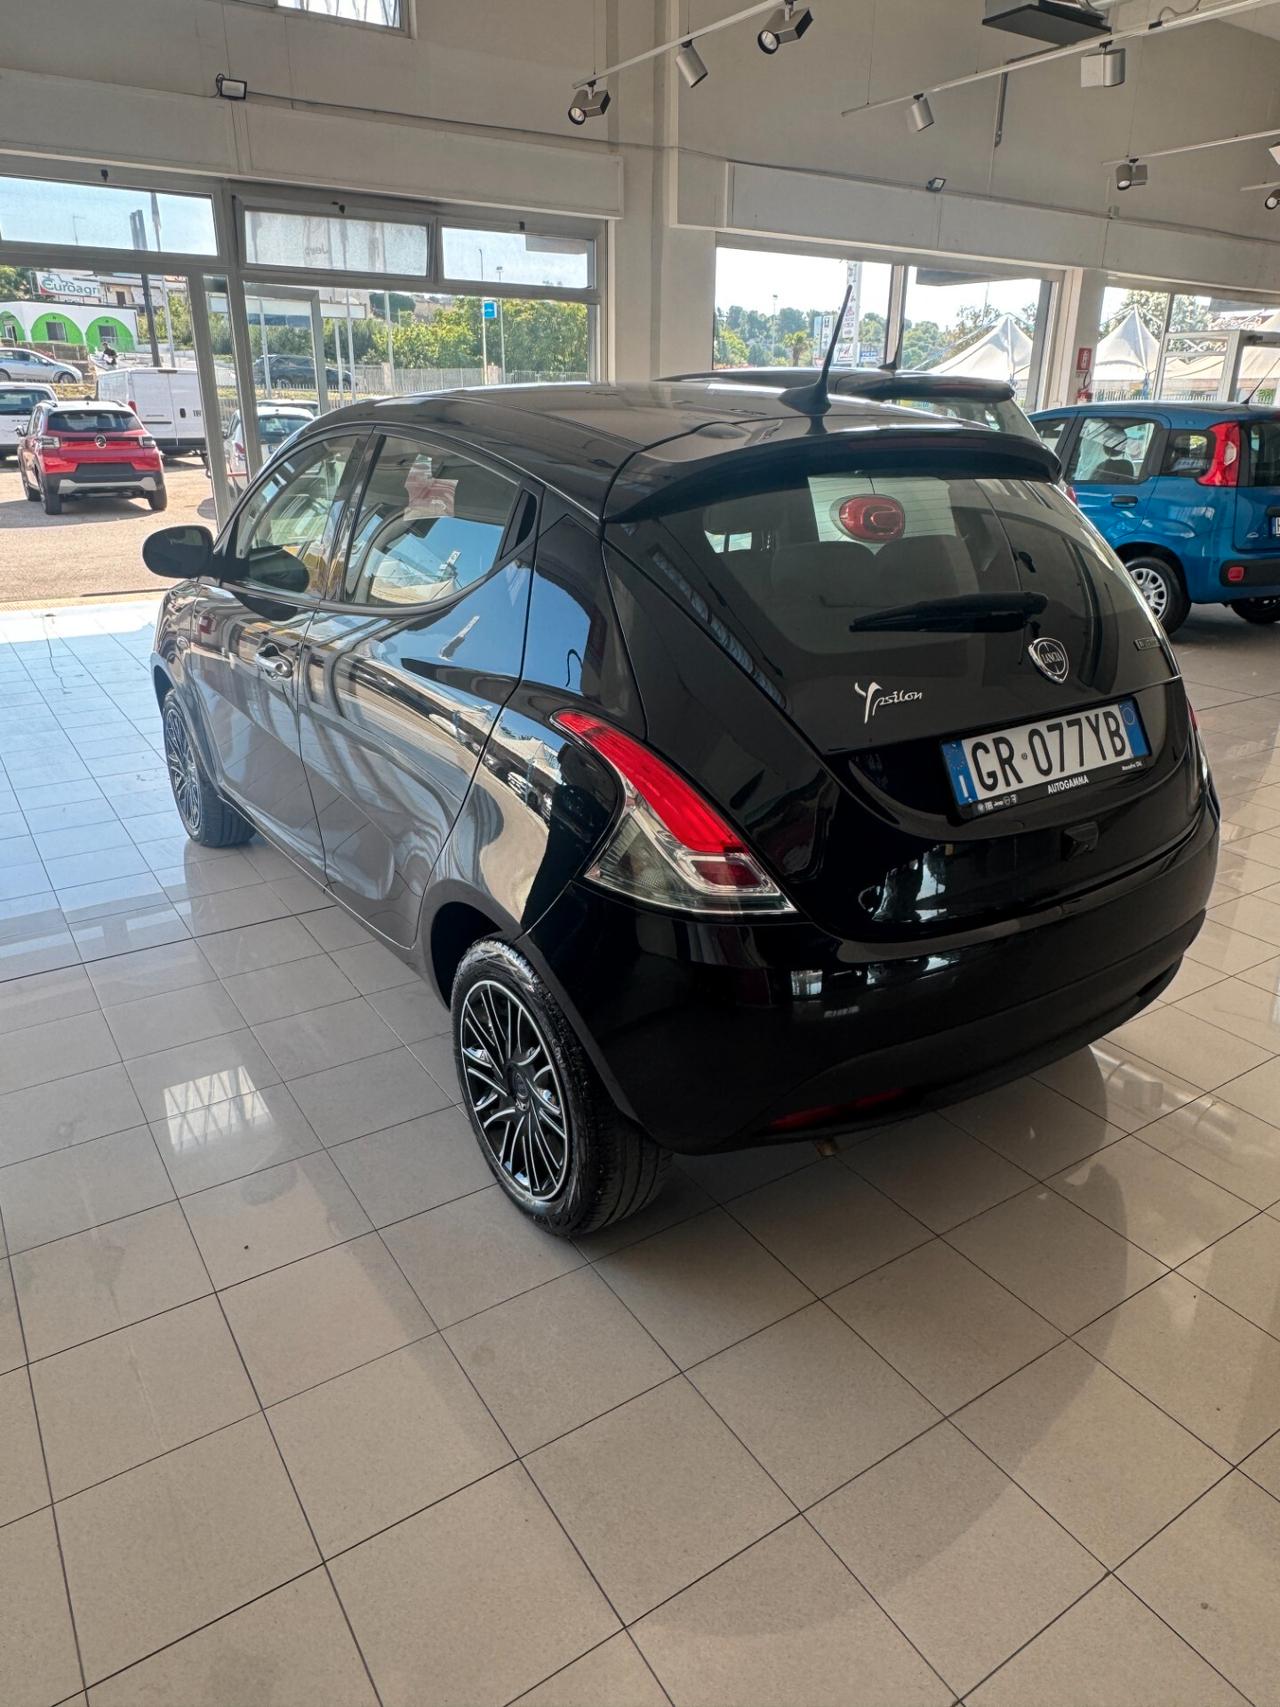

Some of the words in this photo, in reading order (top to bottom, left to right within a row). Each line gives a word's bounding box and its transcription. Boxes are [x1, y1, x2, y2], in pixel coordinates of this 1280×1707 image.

[1041, 651, 1063, 664] LANCIA
[854, 681, 923, 725] Ypsilon
[1047, 774, 1089, 794] AUTOGAMMA
